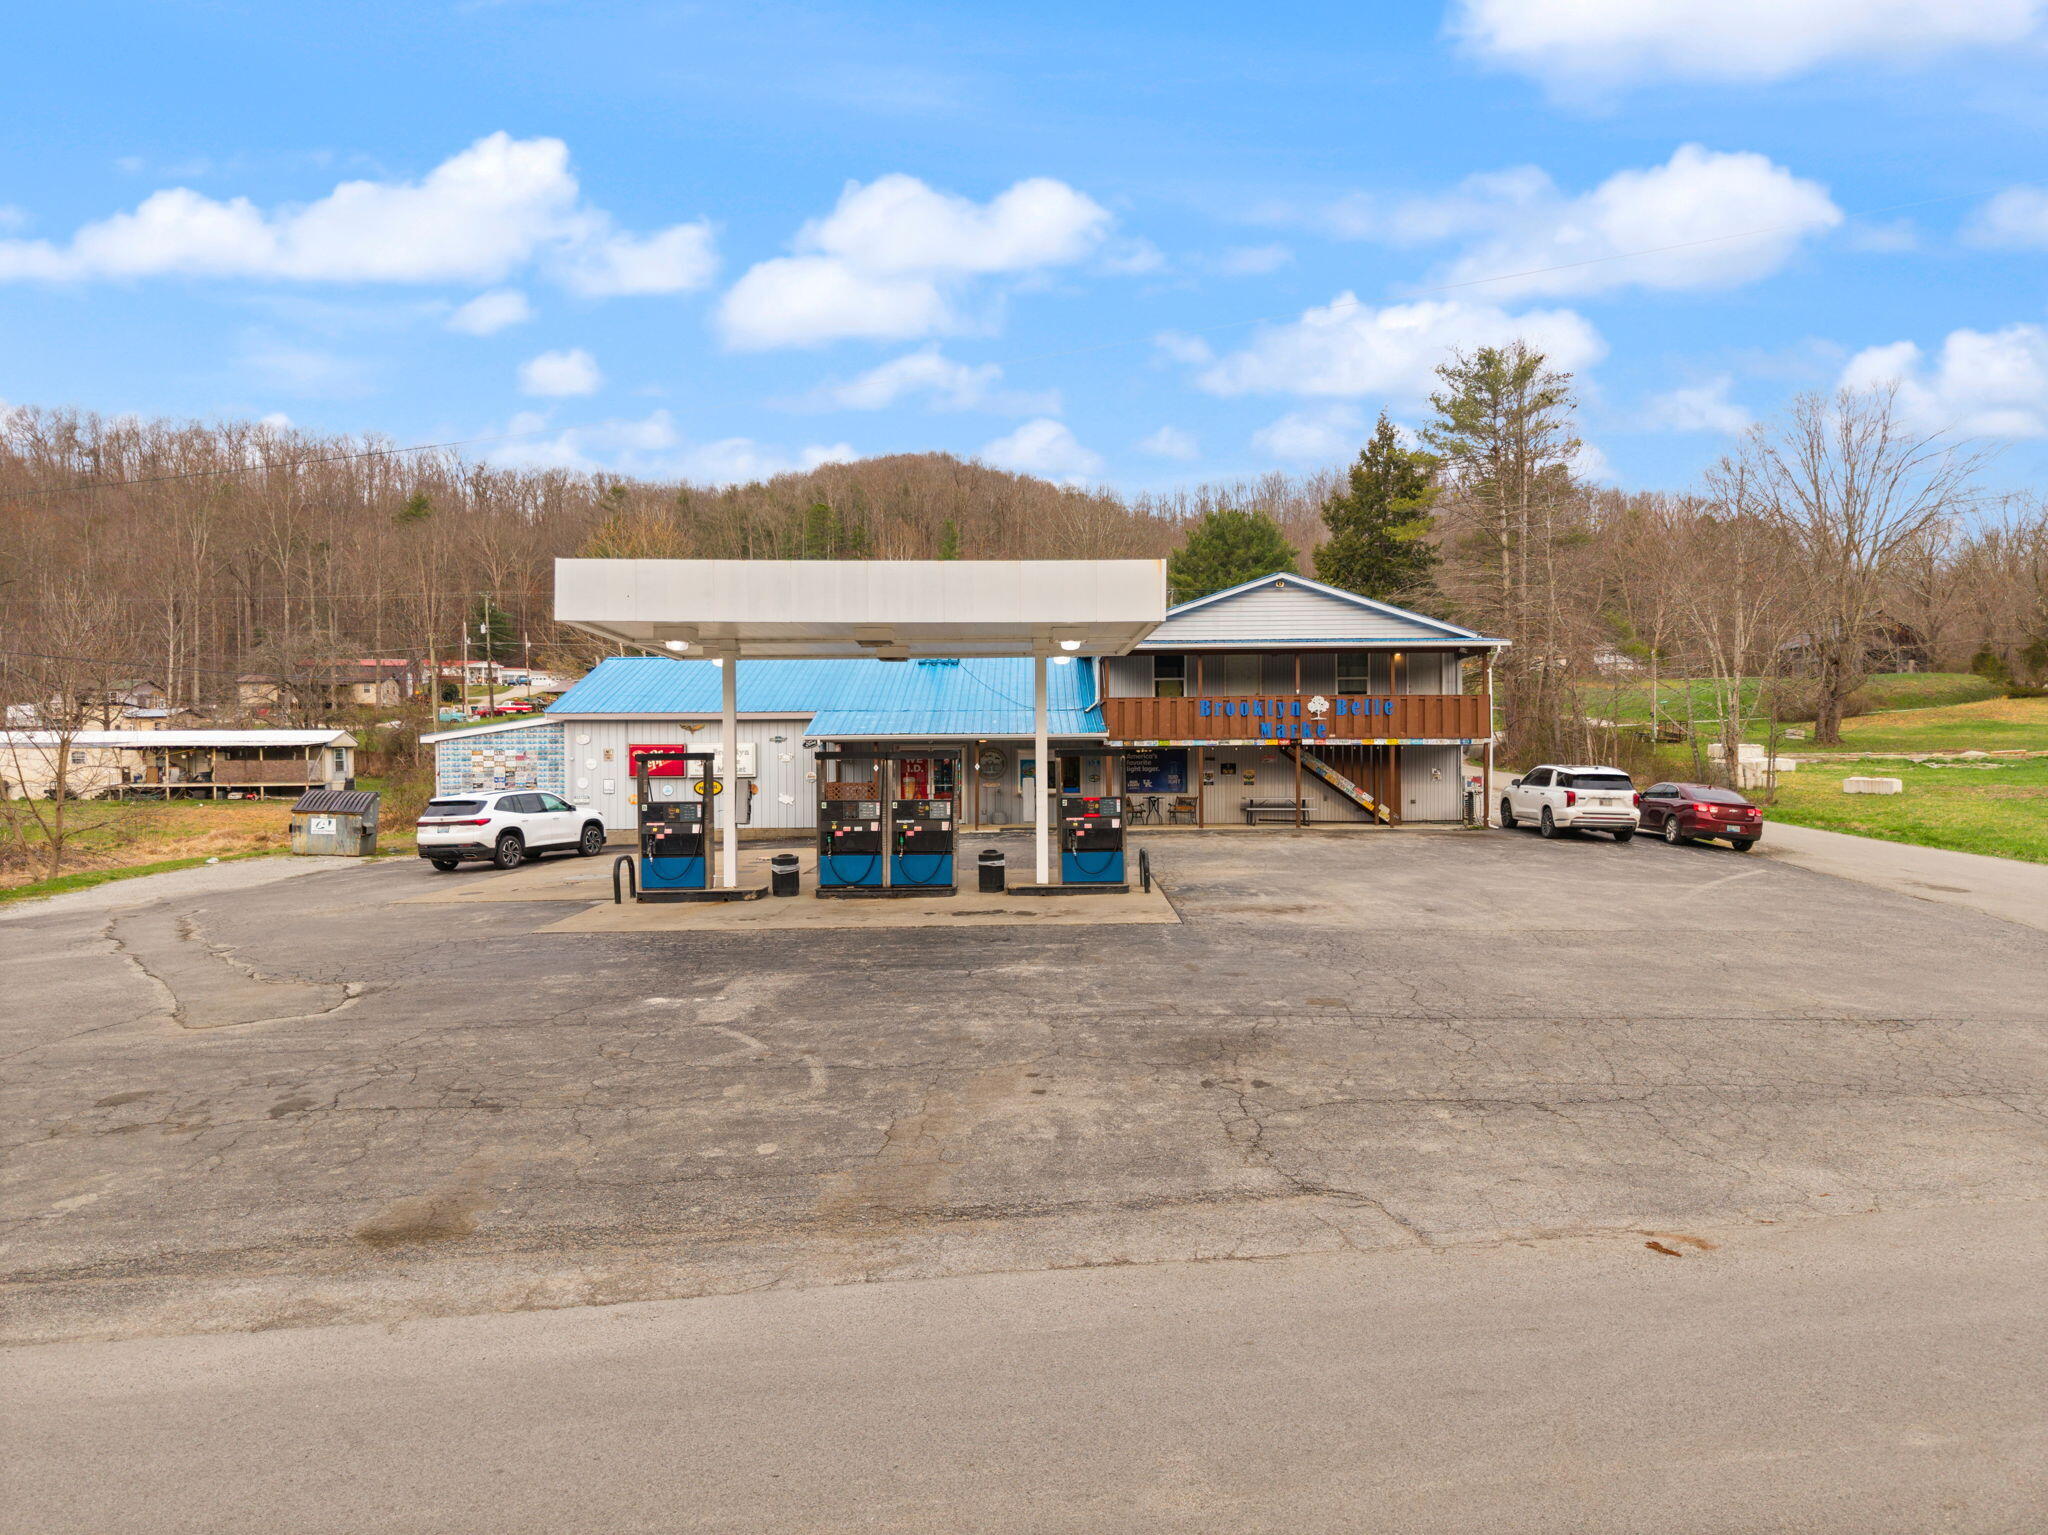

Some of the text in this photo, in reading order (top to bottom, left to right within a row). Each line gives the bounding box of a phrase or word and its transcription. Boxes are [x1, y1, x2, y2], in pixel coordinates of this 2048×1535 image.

[1199, 699, 1394, 719] Brooklyn Belle
[1260, 721, 1328, 739] Marke
[906, 764, 924, 773] I.D.
[1126, 765, 1141, 773] light
